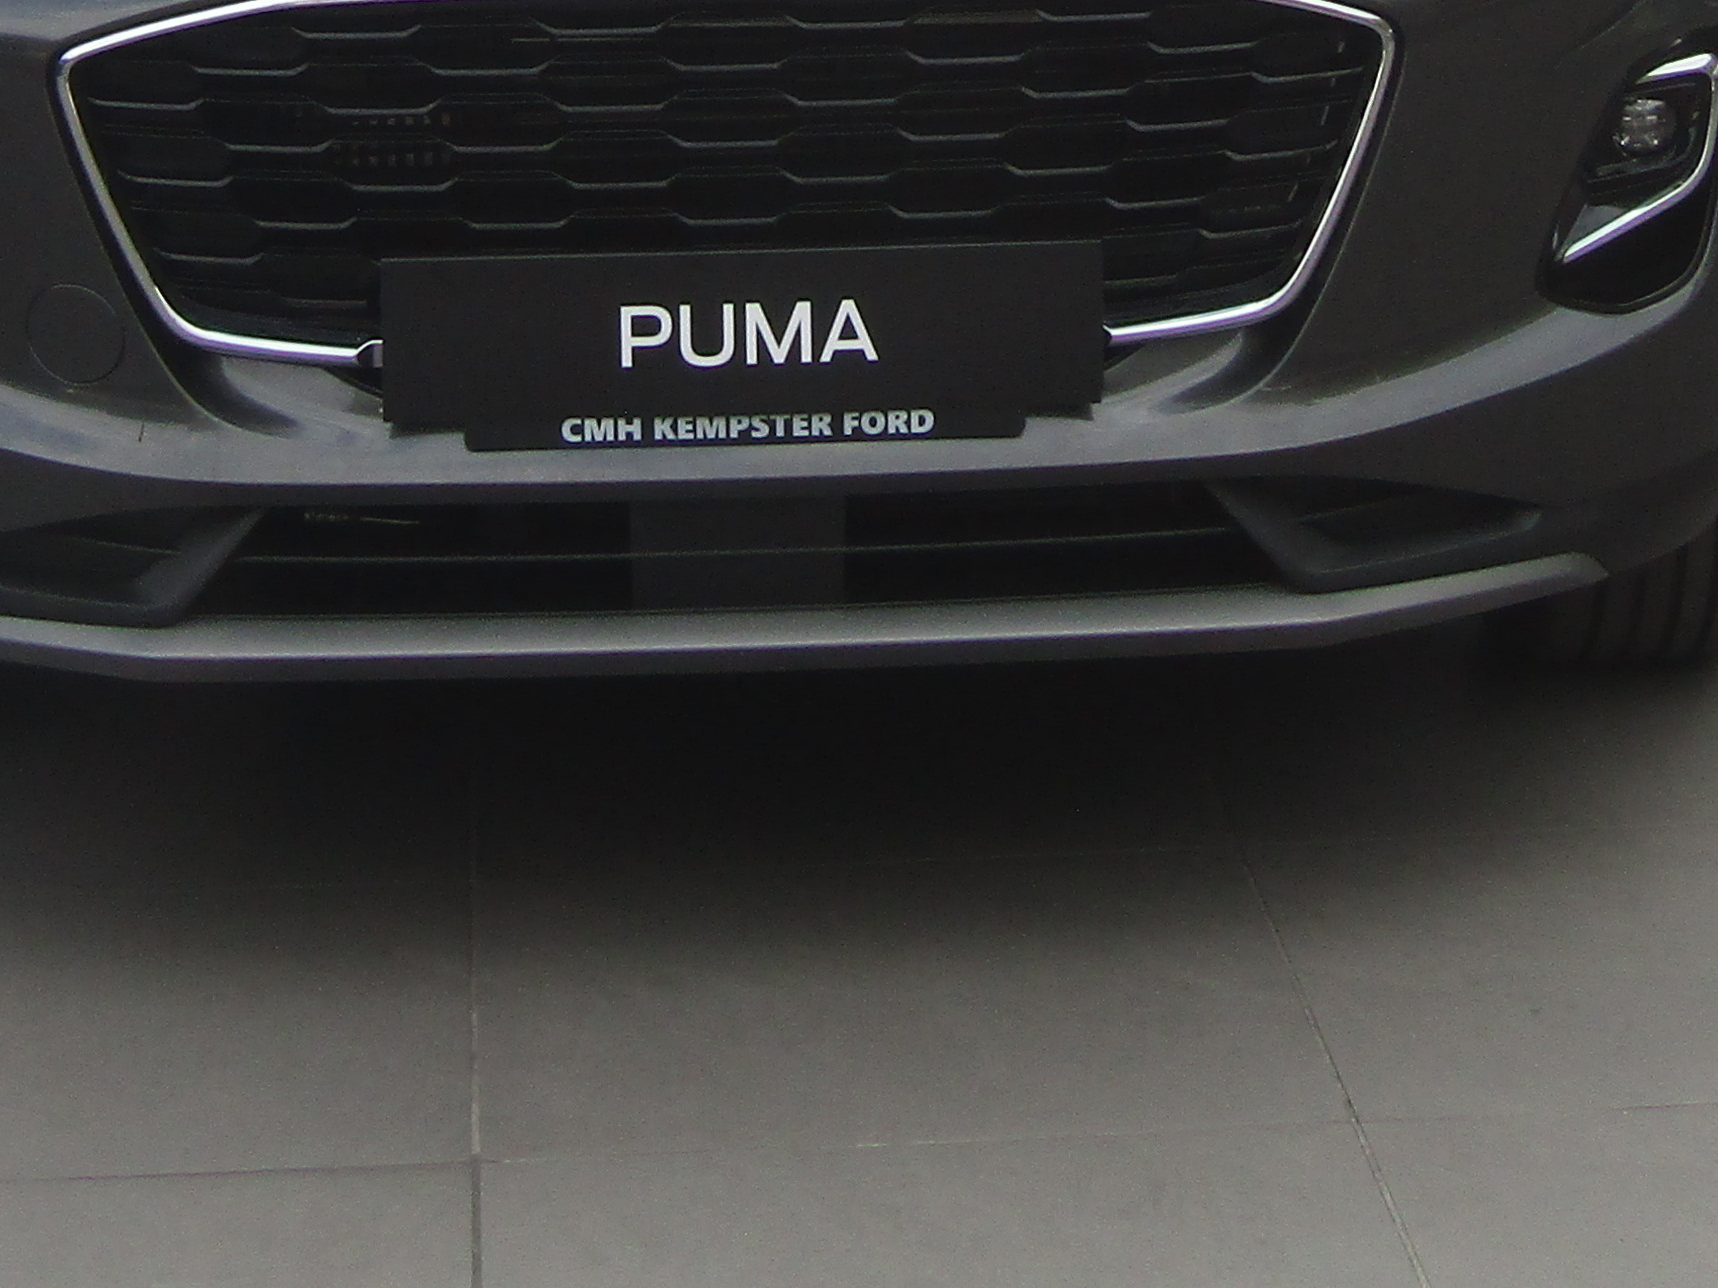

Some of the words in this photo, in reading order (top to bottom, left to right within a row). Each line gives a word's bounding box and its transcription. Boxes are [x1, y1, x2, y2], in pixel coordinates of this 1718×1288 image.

[619, 299, 880, 369] PUMA
[560, 417, 643, 443] CMH
[653, 413, 835, 441] KEMPSTER
[843, 408, 935, 436] FORD
